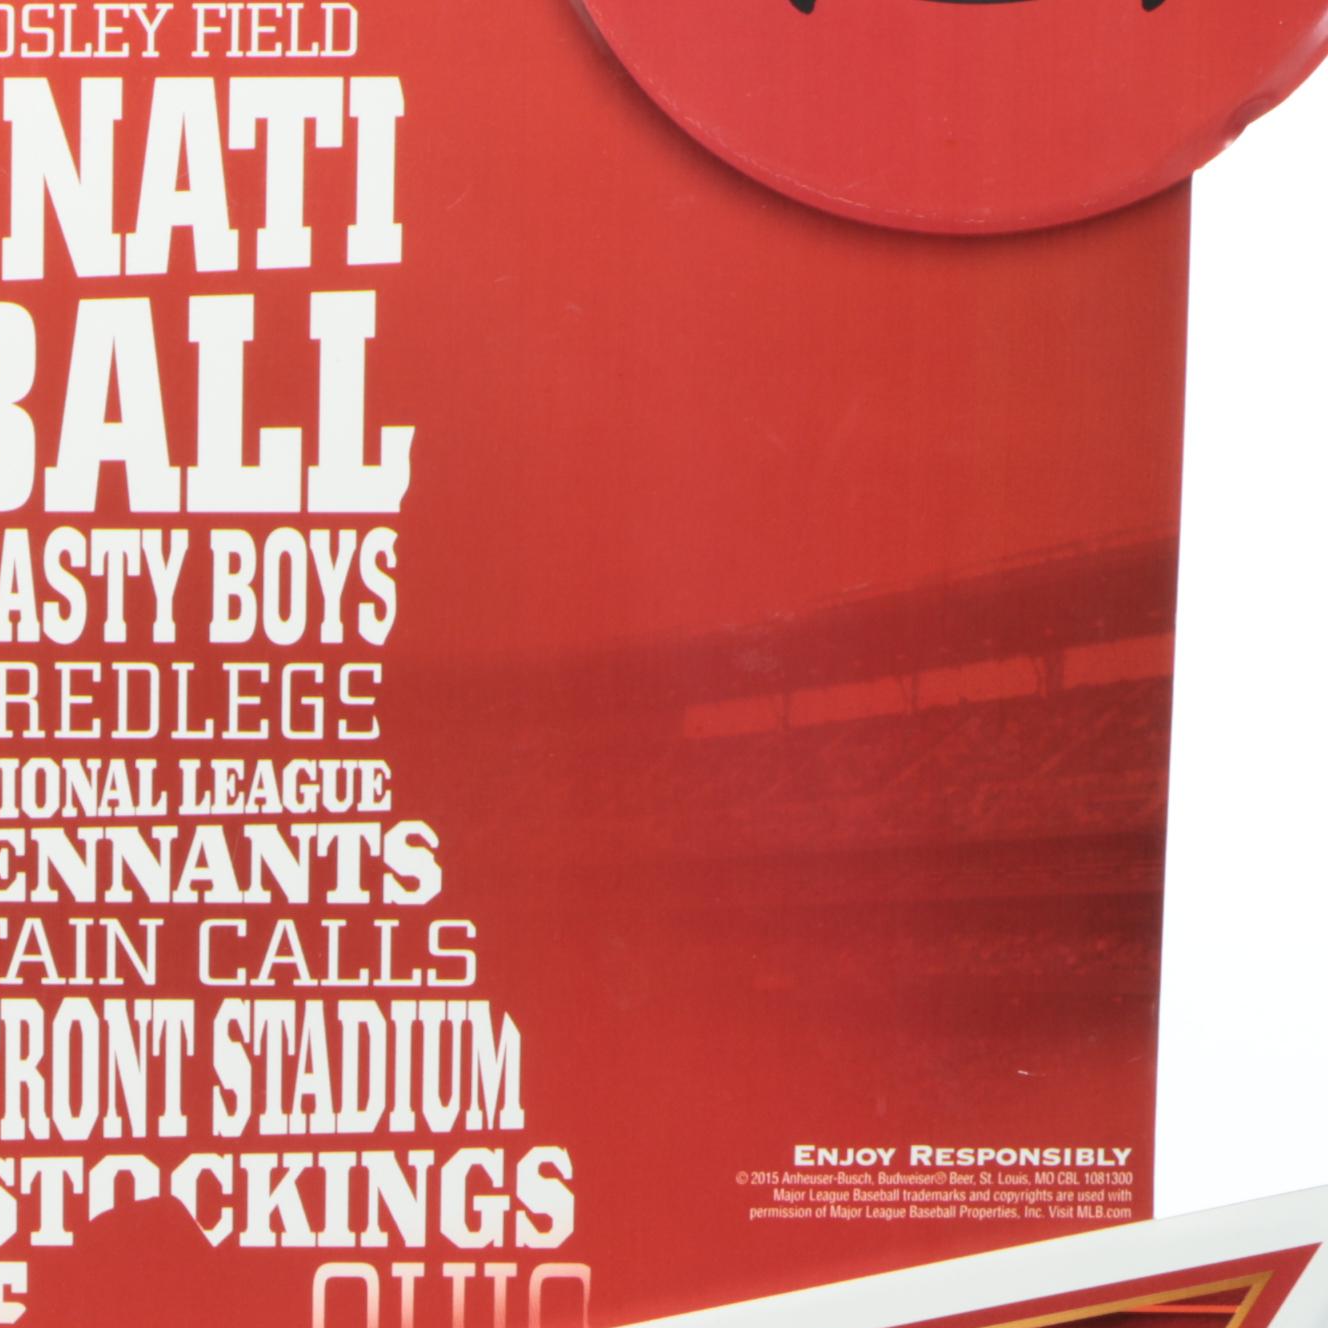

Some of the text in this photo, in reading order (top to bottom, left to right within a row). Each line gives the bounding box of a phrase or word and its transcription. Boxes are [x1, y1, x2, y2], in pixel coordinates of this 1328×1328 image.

[192, 3, 358, 57] FIELD
[210, 527, 397, 645] BOYS
[179, 759, 391, 814] LEAGUE
[199, 919, 476, 986] CALLS
[213, 998, 524, 1137] STADIUM
[751, 1171, 779, 1184] 2015
[782, 1171, 875, 1186] Anheuser-Busch,
[949, 1172, 976, 1186] Beer,
[979, 1172, 993, 1185] St.
[998, 1172, 1031, 1186] Louis,
[1035, 1172, 1054, 1184] MO
[1057, 1172, 1079, 1184] CBL
[1084, 1172, 1133, 1185] 1081300
[794, 1145, 1132, 1166] ENJOY RESPONSIBLY
[750, 1206, 812, 1221] permission
[815, 1205, 827, 1218] of
[830, 1205, 862, 1220] Major
[866, 1205, 907, 1221] League
[909, 1205, 956, 1219] Baseball
[1024, 1206, 1044, 1219] Inc.
[1049, 1205, 1073, 1219] Visit
[1077, 1206, 1132, 1219] MLB.com
[773, 1188, 1132, 1204] Major League Baseball trademarks and copyrights are used with
